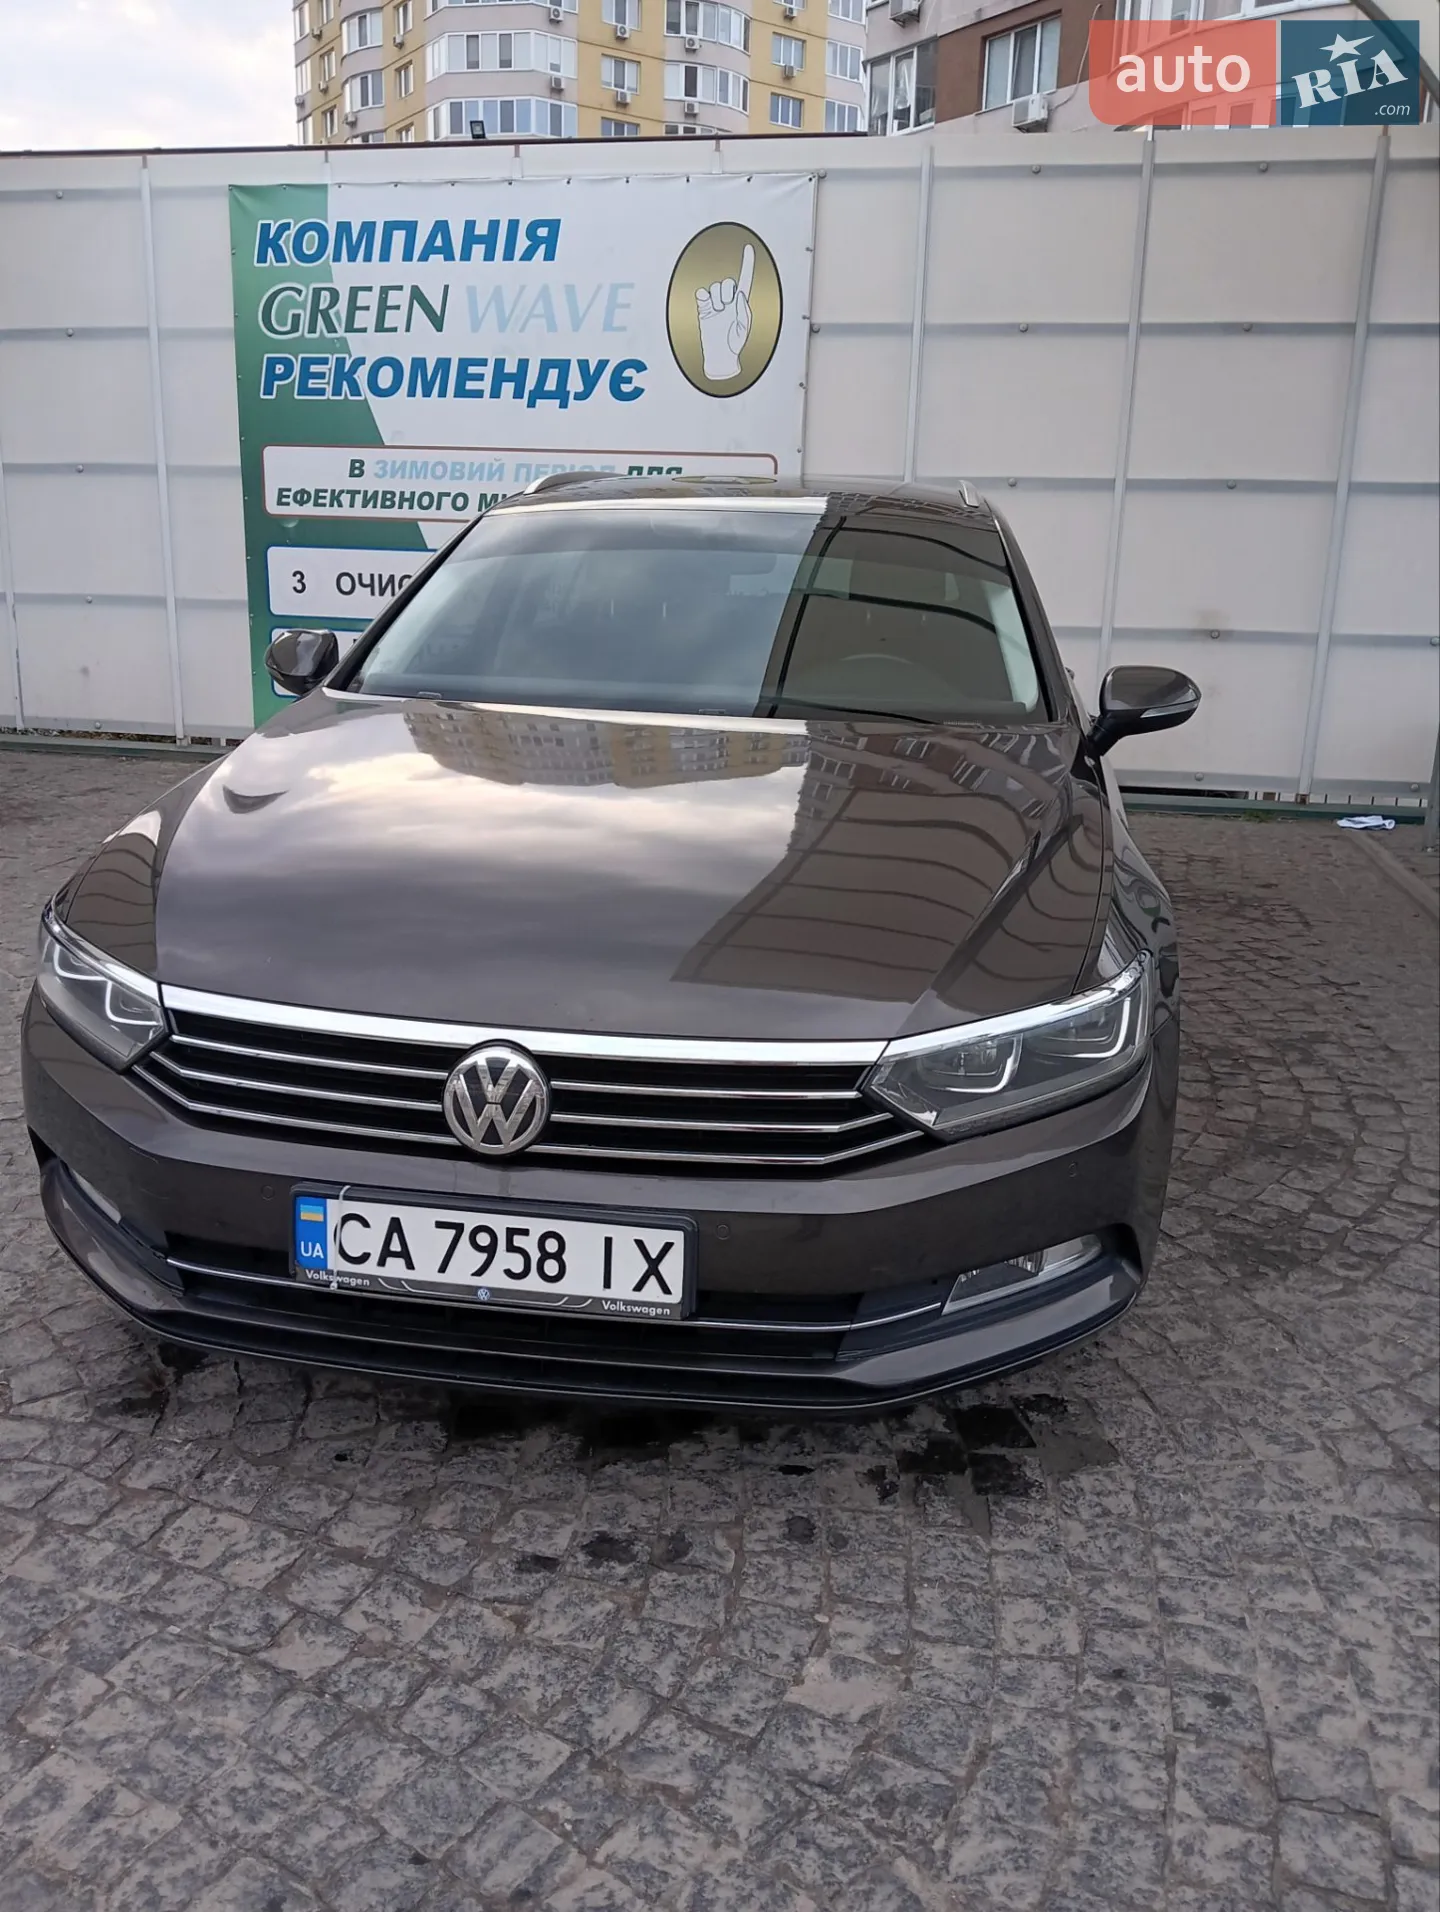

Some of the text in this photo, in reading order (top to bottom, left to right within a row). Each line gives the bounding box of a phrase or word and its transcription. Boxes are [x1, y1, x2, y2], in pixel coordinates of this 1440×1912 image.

[254, 218, 561, 265] КОМПАНІЯ
[260, 282, 636, 336] GREEN WAVE
[261, 355, 649, 409] РЕКОМЕНДУЄ
[348, 459, 366, 478] В
[373, 458, 506, 482] ЗИМОВИЙ
[276, 487, 470, 512] ЕФЕКТИВНОГО
[292, 570, 307, 594] 3
[300, 1240, 325, 1260] UA
[334, 1213, 675, 1296] CA 7958 IX
[305, 1269, 370, 1287] Volkswagen
[602, 1299, 671, 1317] Volkswagen
